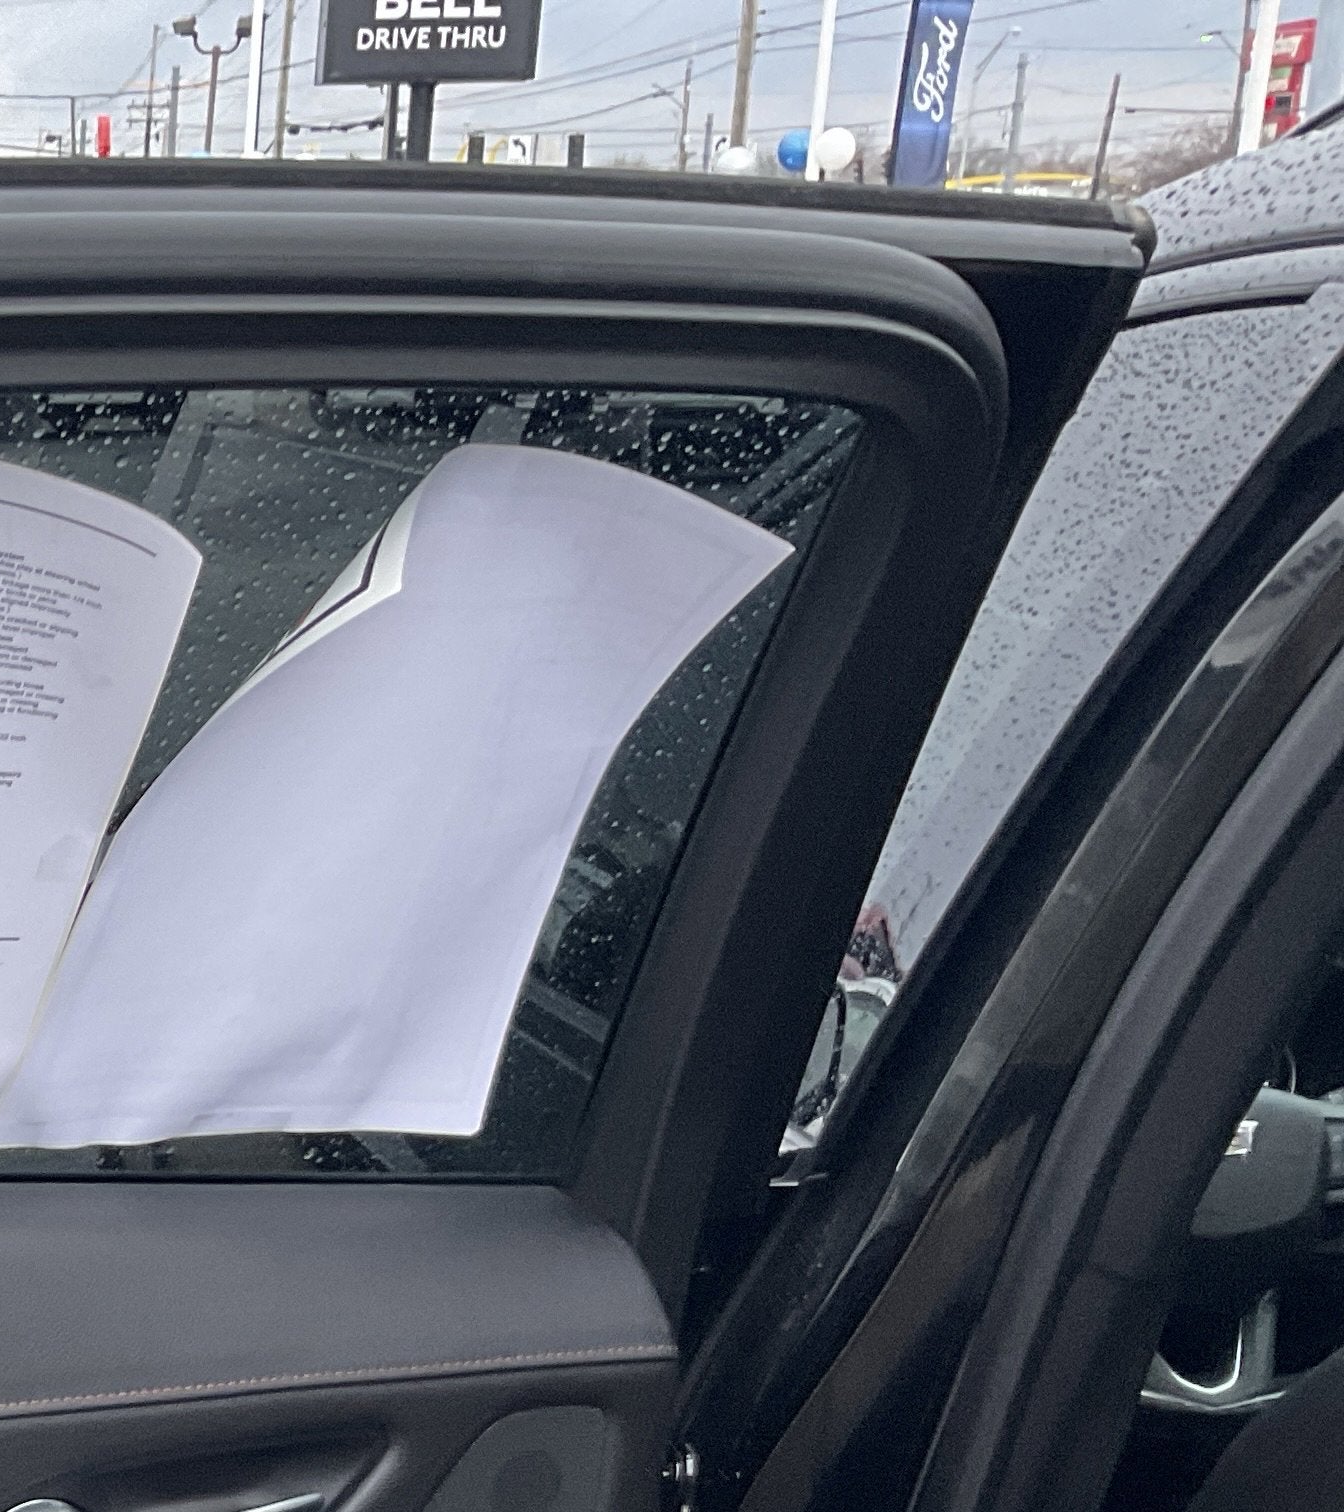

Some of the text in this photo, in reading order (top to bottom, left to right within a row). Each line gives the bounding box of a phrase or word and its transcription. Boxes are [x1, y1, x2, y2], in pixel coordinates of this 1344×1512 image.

[375, 0, 501, 20] BELL
[356, 25, 506, 50] DRIVE THRU
[913, 15, 958, 122] Ford
